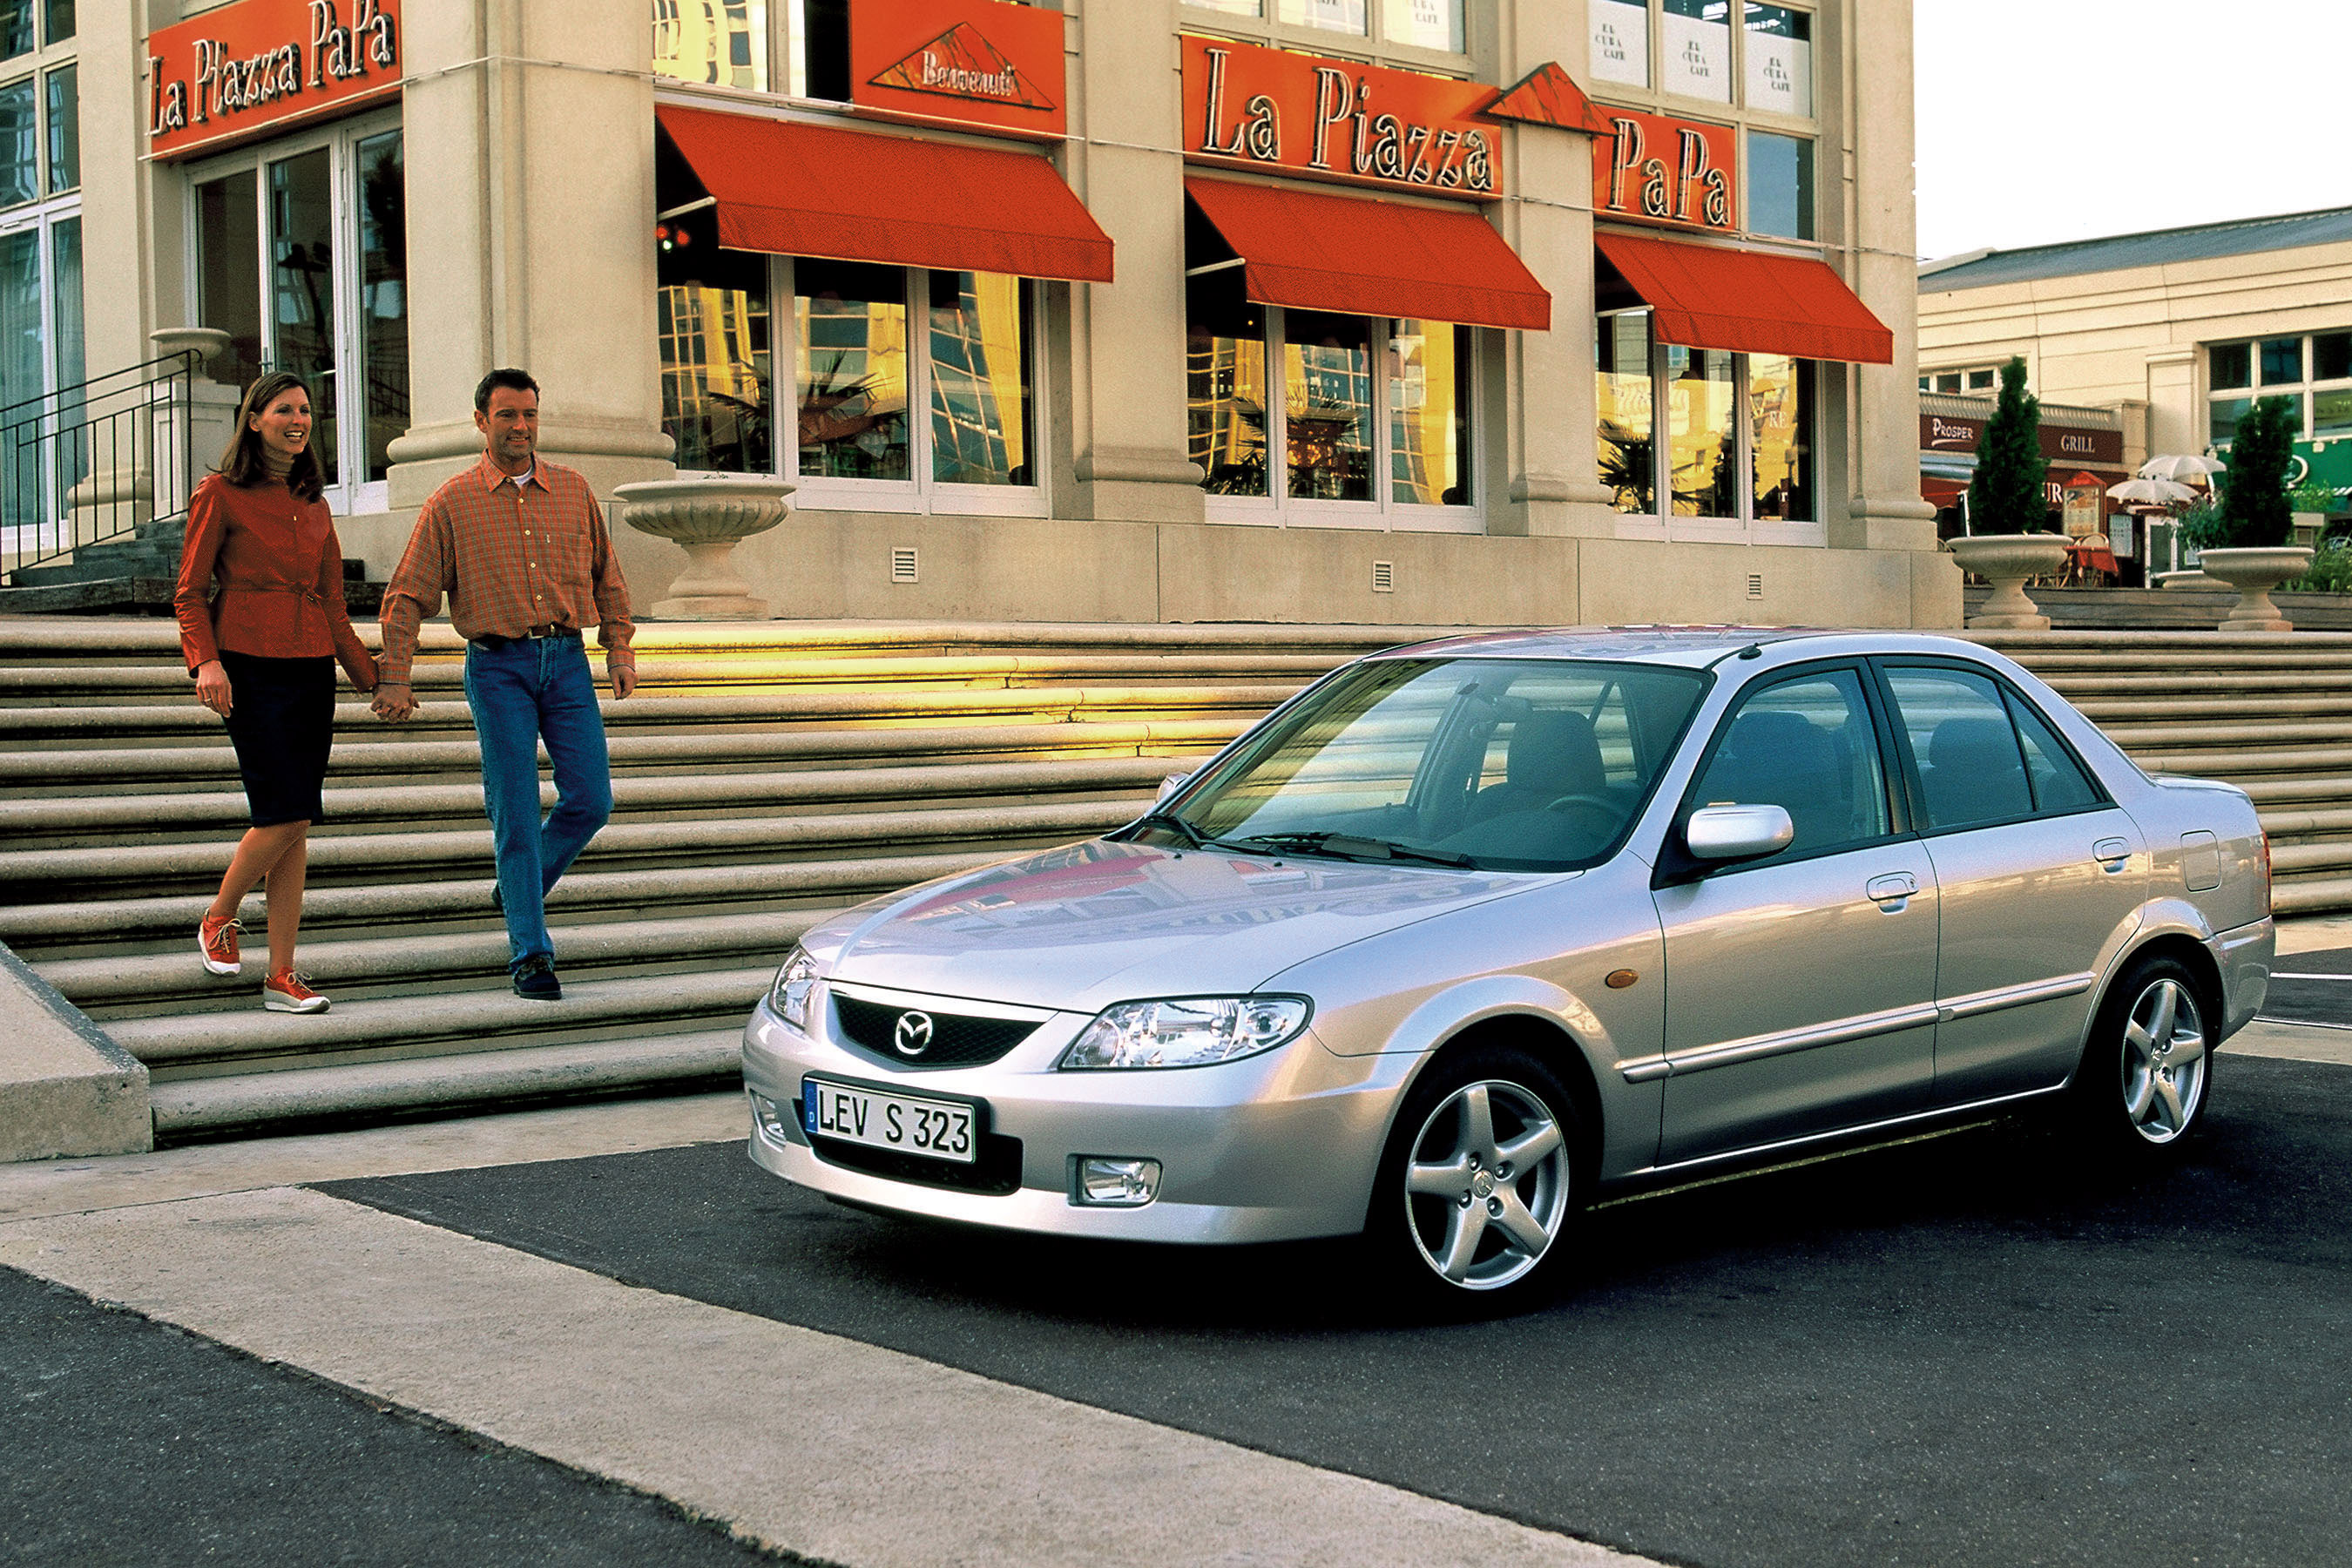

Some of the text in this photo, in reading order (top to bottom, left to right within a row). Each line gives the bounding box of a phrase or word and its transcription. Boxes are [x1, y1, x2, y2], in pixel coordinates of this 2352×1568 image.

[1595, 35, 1622, 48] CUBA
[1604, 49, 1625, 60] CAFE
[1682, 51, 1707, 65] CUBA
[145, 0, 395, 136] La Piazza PaPa
[1690, 66, 1710, 78] CAFE
[1763, 67, 1788, 80] CUBA
[1770, 81, 1791, 92] CAFE
[1201, 47, 1731, 226] La Piazza PaPa
[2060, 435, 2096, 453] GRILL
[819, 1090, 970, 1153] LEV S 323
